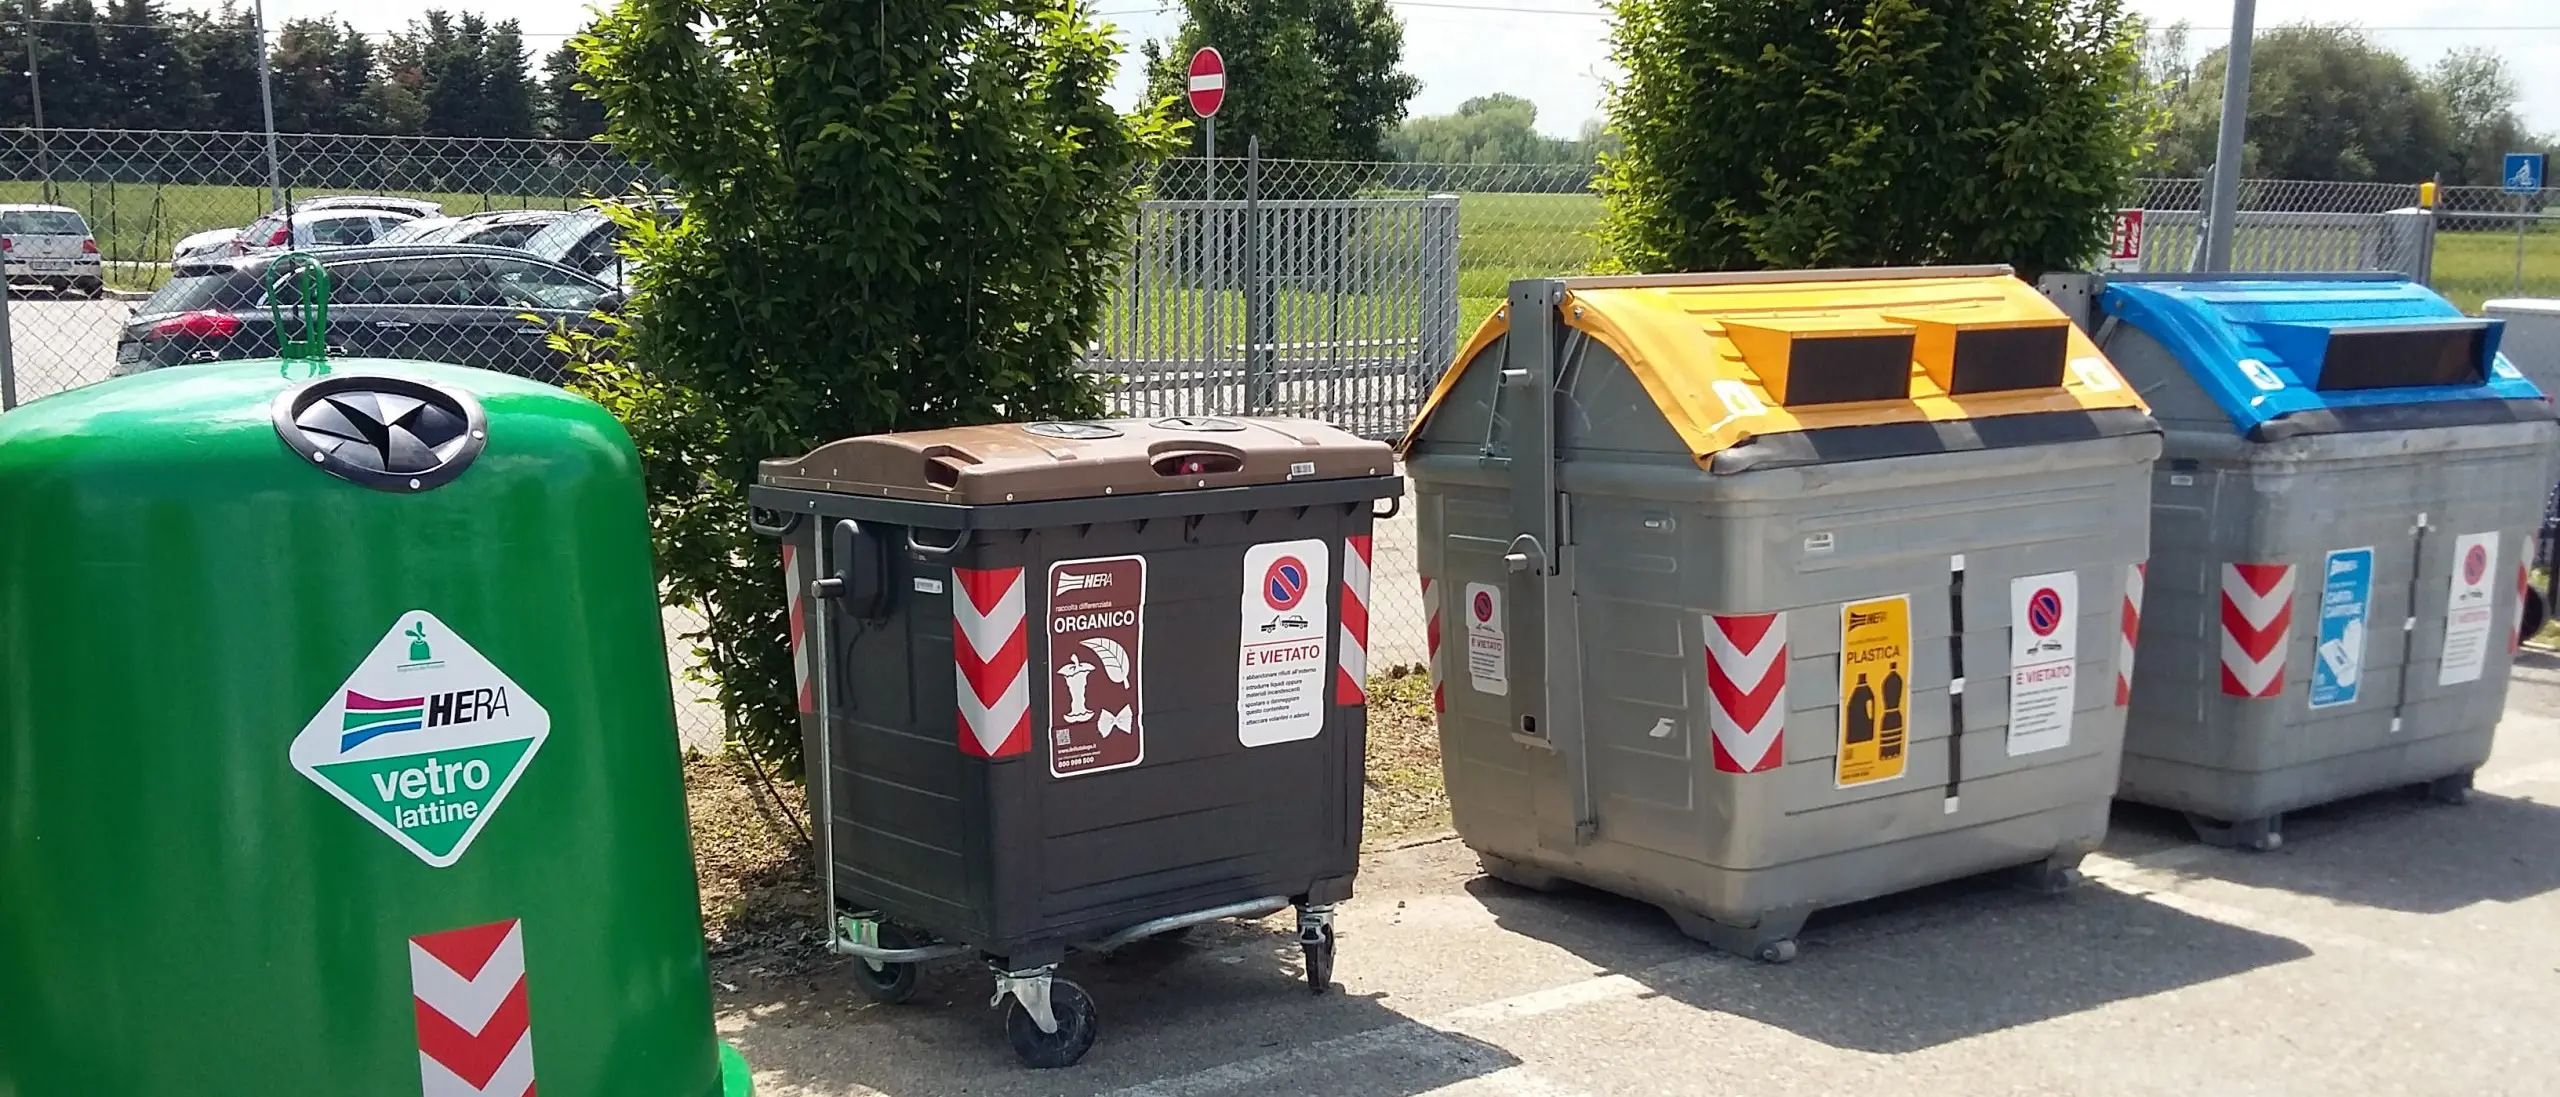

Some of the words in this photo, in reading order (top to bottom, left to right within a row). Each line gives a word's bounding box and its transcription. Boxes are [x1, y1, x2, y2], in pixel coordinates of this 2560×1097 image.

[1083, 572, 1113, 589] HERA
[1055, 603, 1078, 612] raccolta
[1079, 601, 1112, 610] differenziata
[1054, 610, 1135, 633] ORGANICO
[1246, 648, 1255, 666] È
[1260, 645, 1320, 664] VIETATO
[1477, 640, 1502, 651] VIETATO
[1846, 645, 1900, 665] PLASTICA
[2026, 664, 2071, 683] VIETATO
[427, 686, 510, 728] HERA
[371, 757, 491, 803] vetro
[395, 798, 479, 829] lattine
